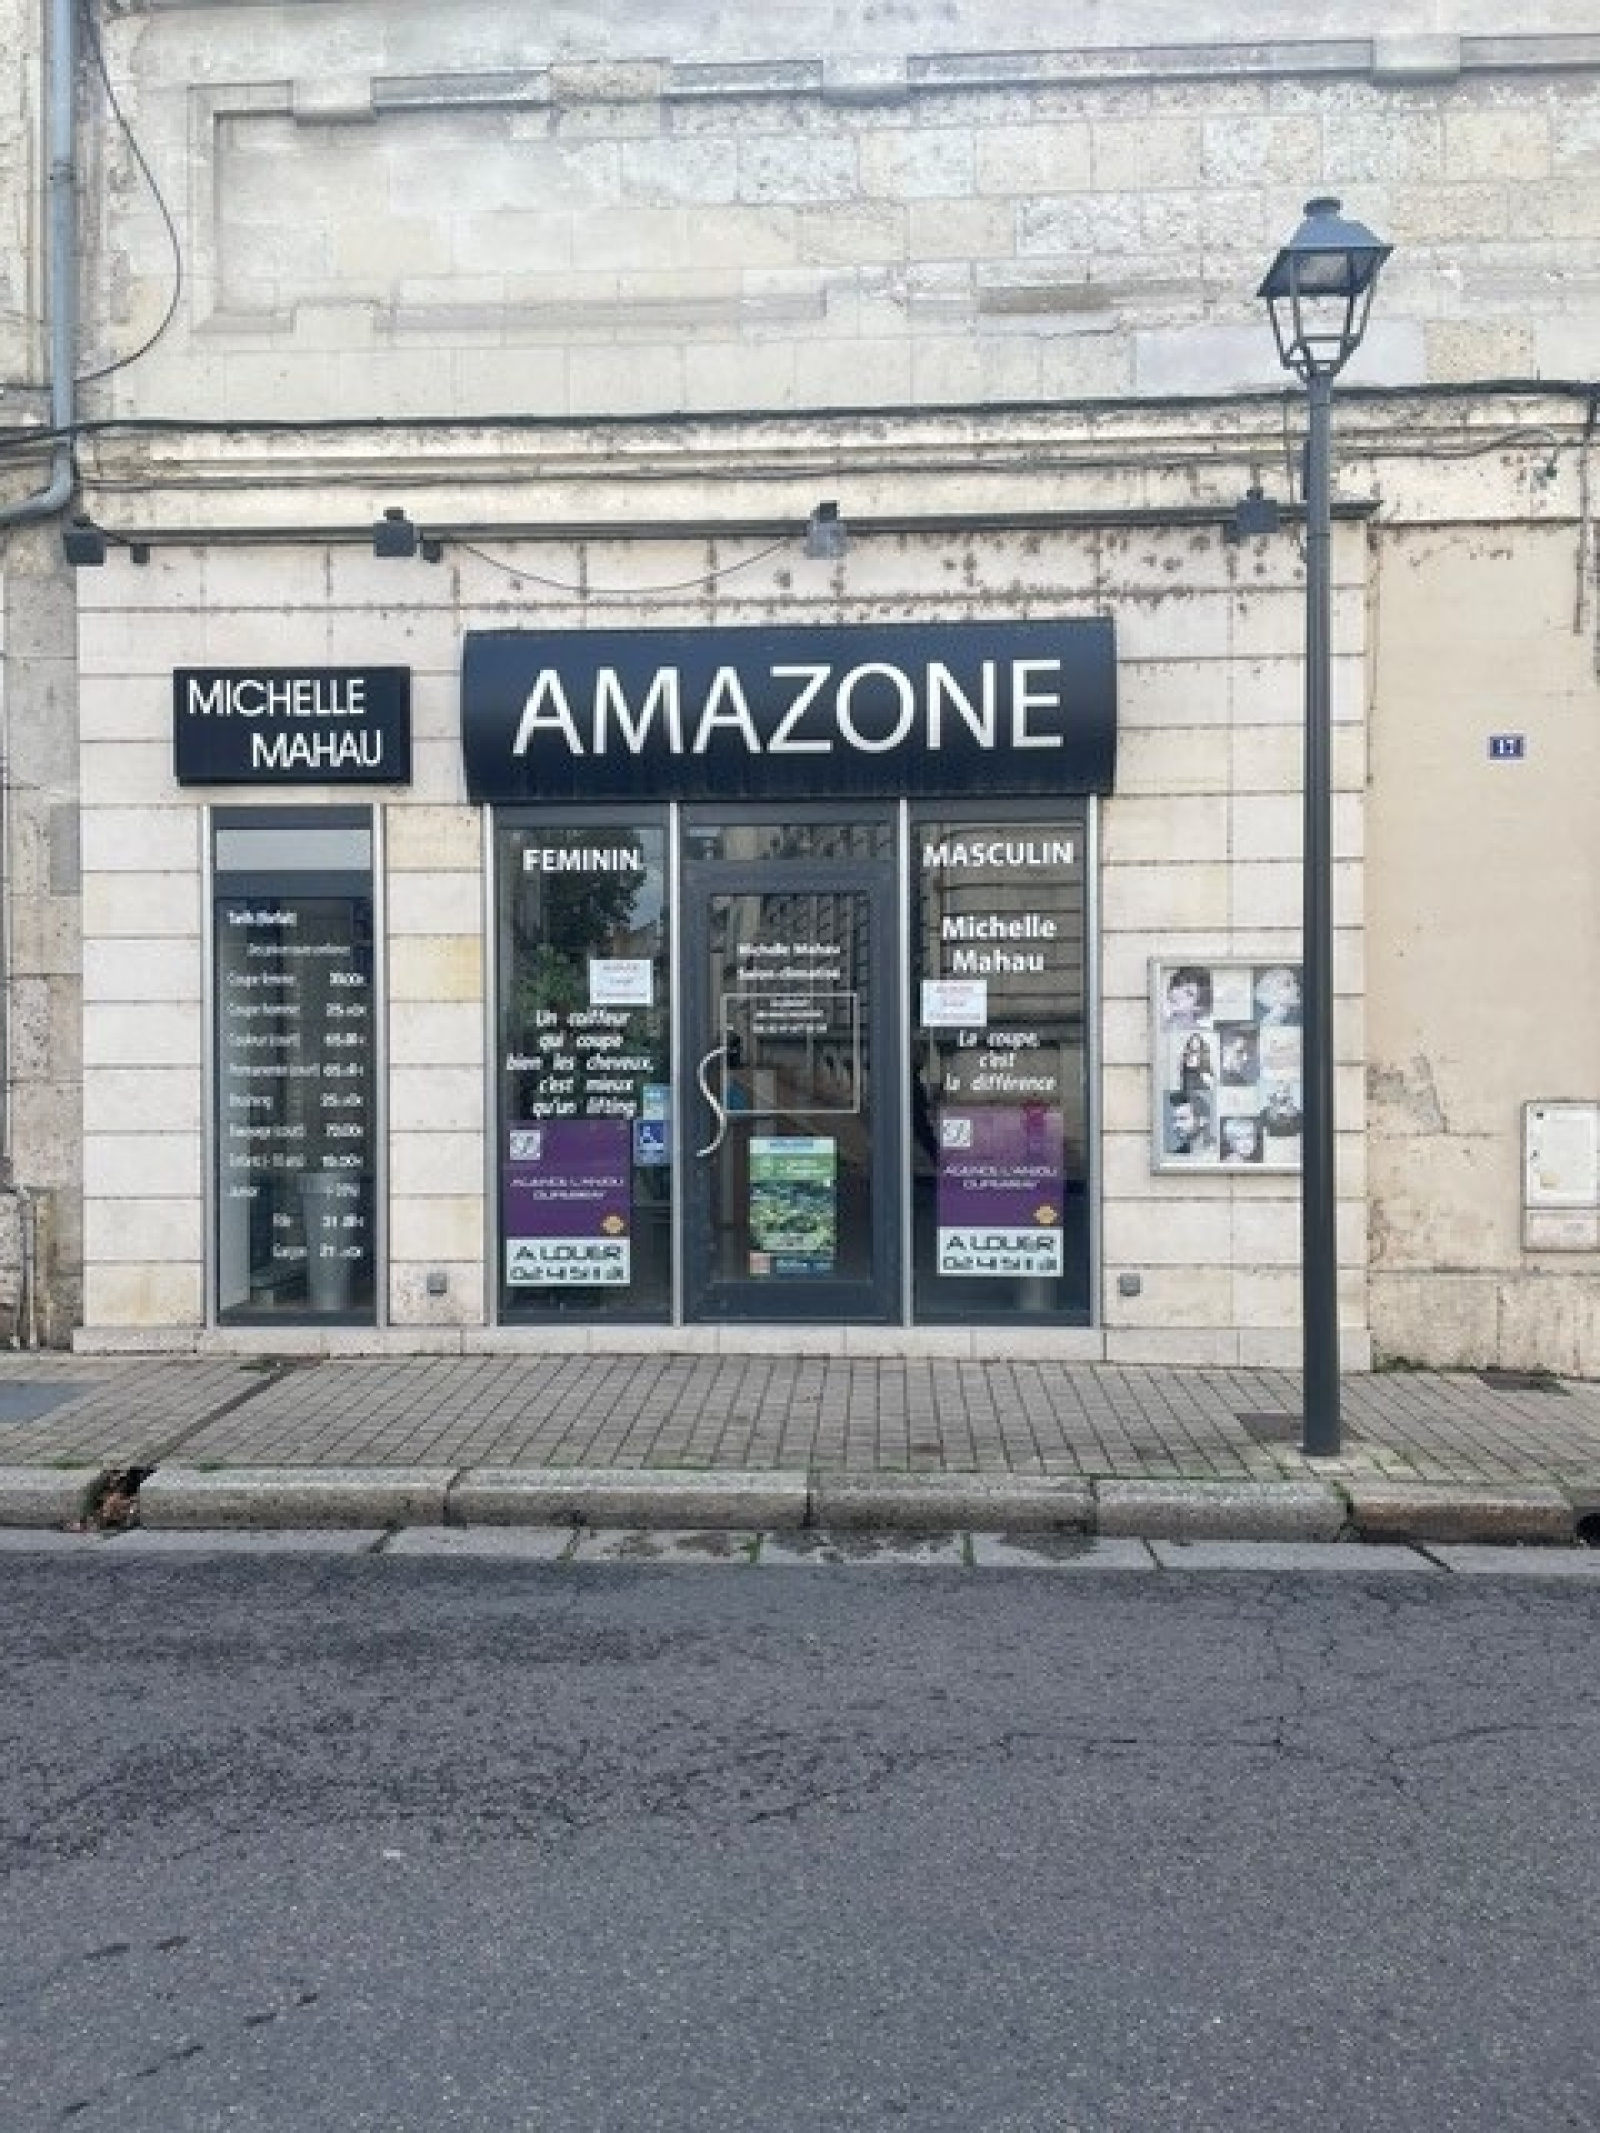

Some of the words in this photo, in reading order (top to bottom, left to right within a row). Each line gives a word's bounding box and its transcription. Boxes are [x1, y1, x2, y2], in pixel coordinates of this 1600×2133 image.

[187, 679, 366, 717] MICHELLE
[512, 659, 1065, 756] AMAZONE
[251, 729, 383, 769] MAHAU
[522, 848, 640, 872] FEMININ
[922, 840, 1075, 867] MASCULIN
[942, 913, 1057, 940] Michelle
[952, 949, 1044, 973] Mahau
[536, 1009, 557, 1027] Un
[567, 1008, 632, 1027] coiffeur
[537, 1031, 567, 1052] qui
[576, 1034, 624, 1051] coupe
[957, 1029, 978, 1047] La
[506, 1053, 543, 1070] bien
[552, 1053, 576, 1070] les
[586, 1076, 634, 1093] mieux
[945, 1072, 961, 1091] la
[970, 1072, 1057, 1091] différence
[586, 1096, 637, 1119] lifting
[513, 1246, 537, 1260] A
[540, 1246, 622, 1261] LOUER
[946, 1236, 968, 1251] A
[970, 1236, 1056, 1253] LOUER
